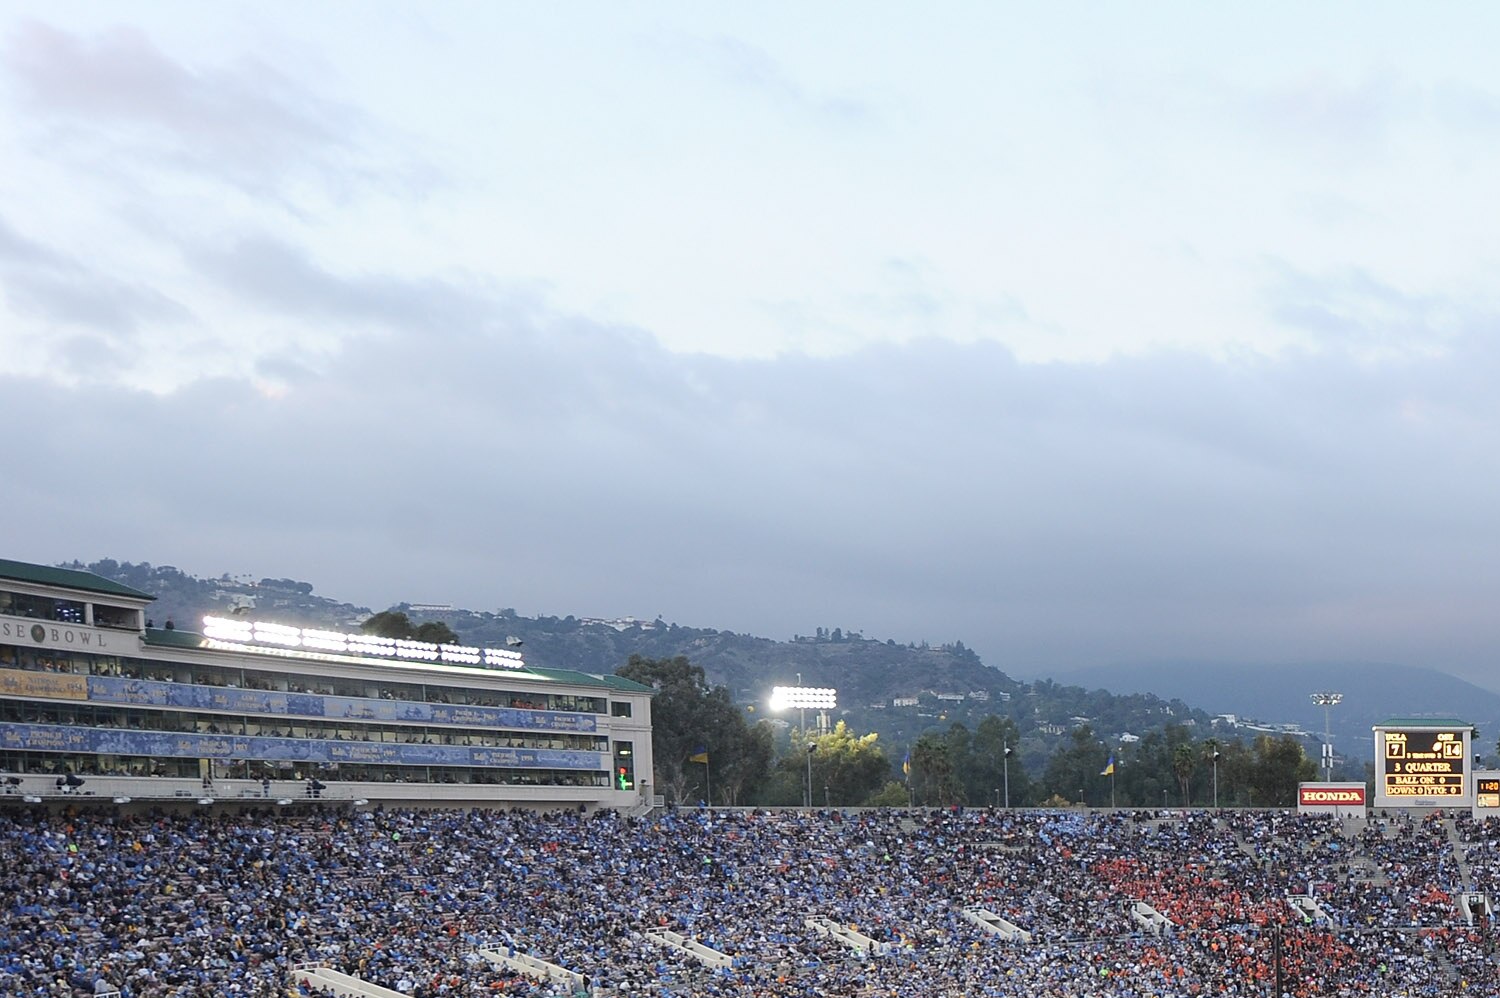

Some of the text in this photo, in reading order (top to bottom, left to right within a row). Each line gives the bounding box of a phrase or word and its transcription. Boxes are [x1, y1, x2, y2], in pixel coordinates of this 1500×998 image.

[51, 629, 107, 647] BOWL
[1391, 744, 1400, 755] 7
[1446, 744, 1460, 756] 14
[1394, 763, 1451, 772] 3 QUARTER
[1395, 776, 1446, 784] BALL ON: 0
[1387, 786, 1417, 795] DOWN:
[1450, 786, 1456, 795] 0
[1302, 791, 1362, 801] HONDA
